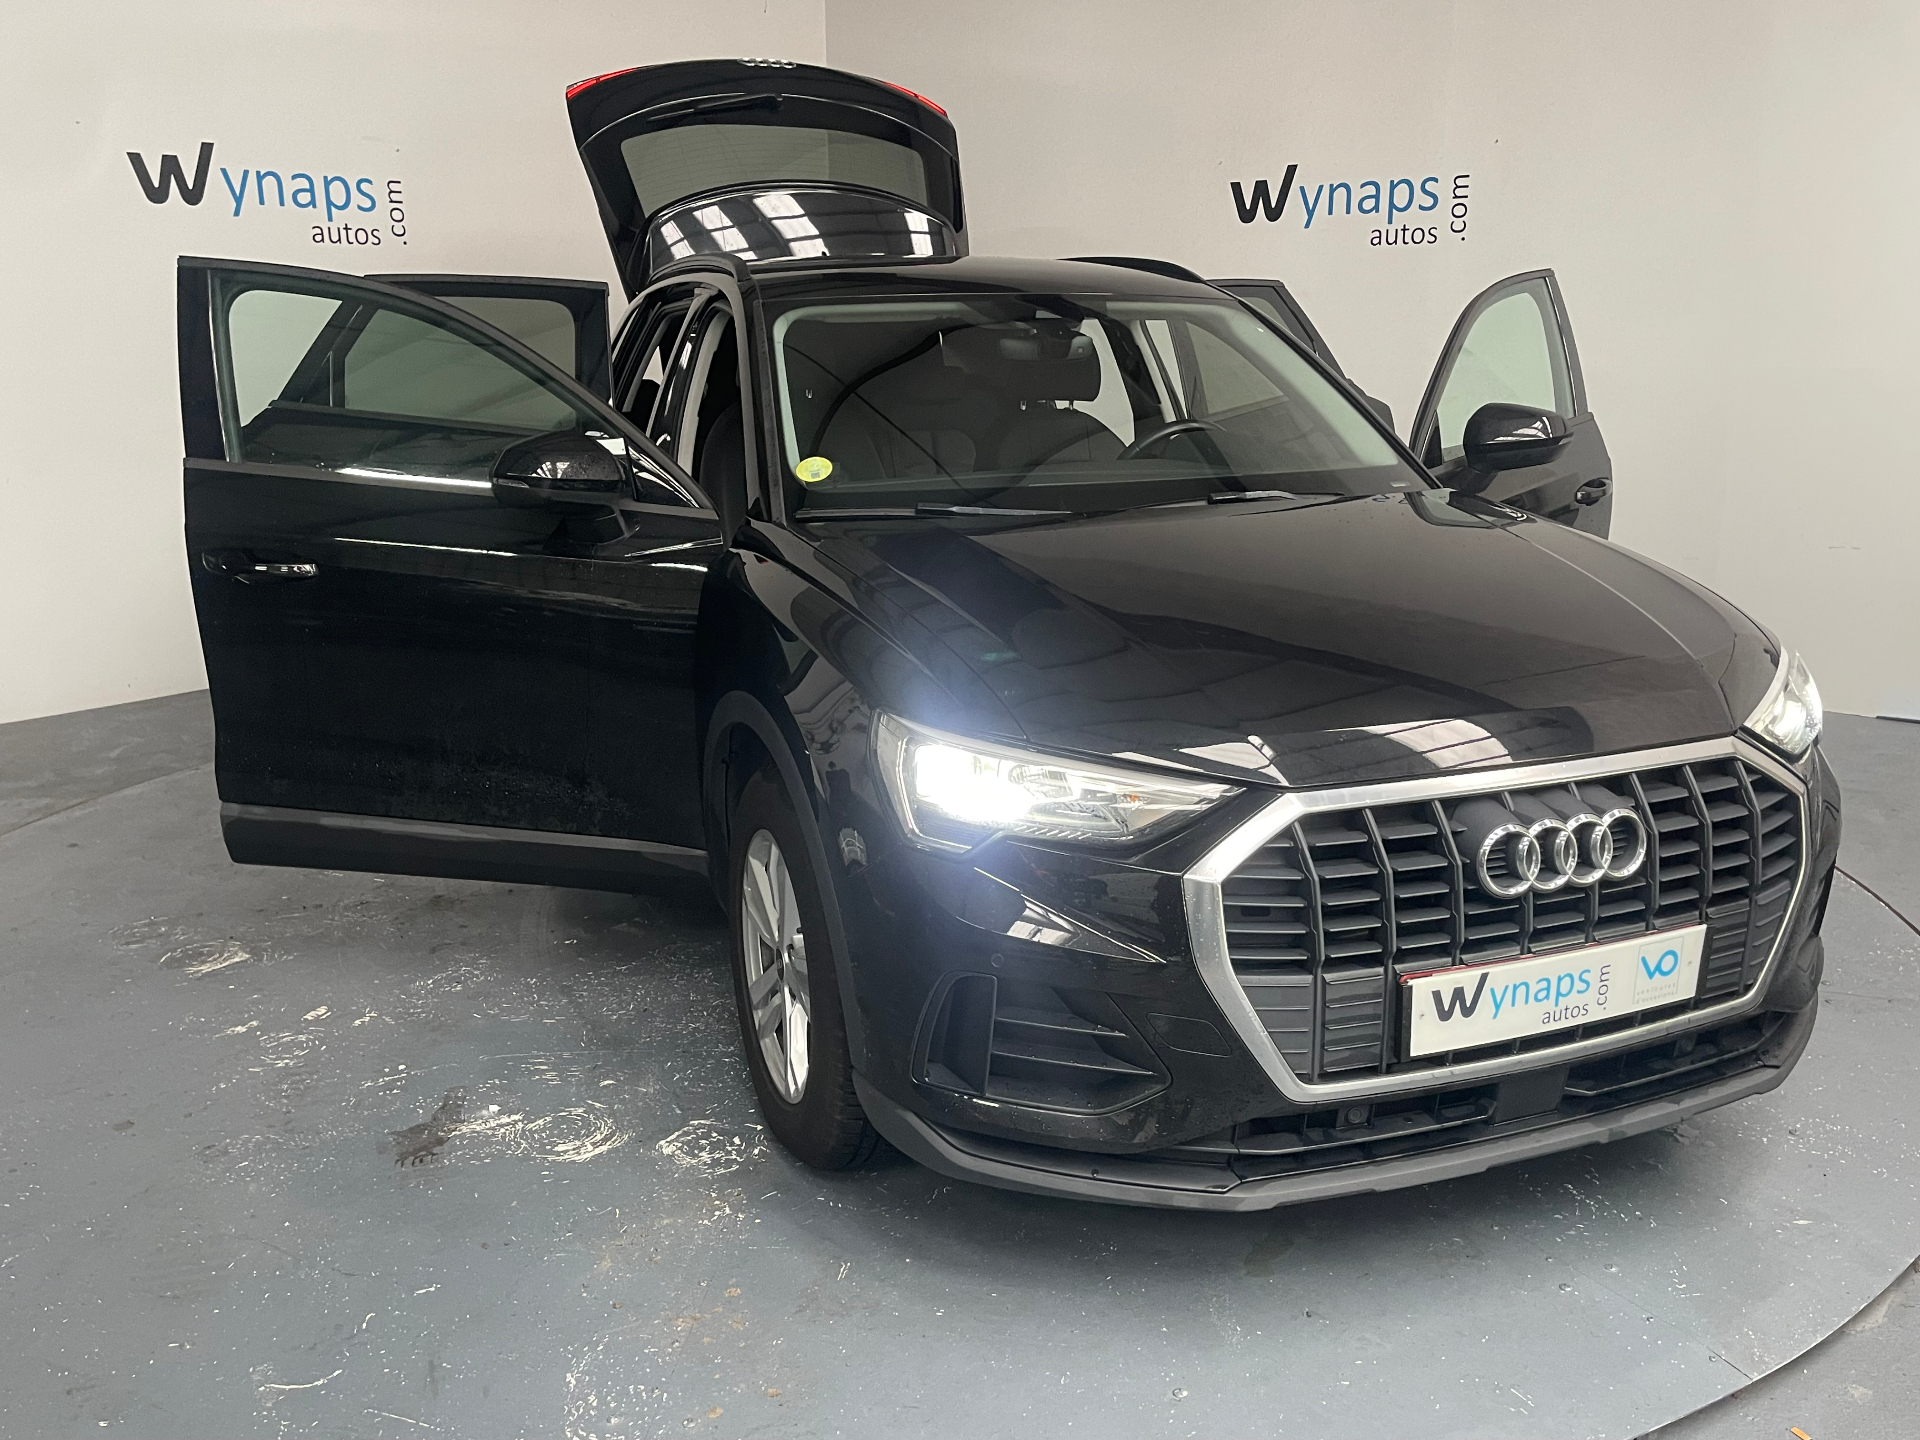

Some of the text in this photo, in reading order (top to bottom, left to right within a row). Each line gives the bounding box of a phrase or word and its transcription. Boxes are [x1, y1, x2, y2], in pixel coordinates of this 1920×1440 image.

[126, 141, 378, 223] Wynaps
[1229, 163, 1440, 229] Wynaps
[311, 222, 382, 246] autos
[1369, 223, 1439, 247] autos
[1431, 968, 1592, 1022] Wynaps
[1541, 1001, 1590, 1025] autos
